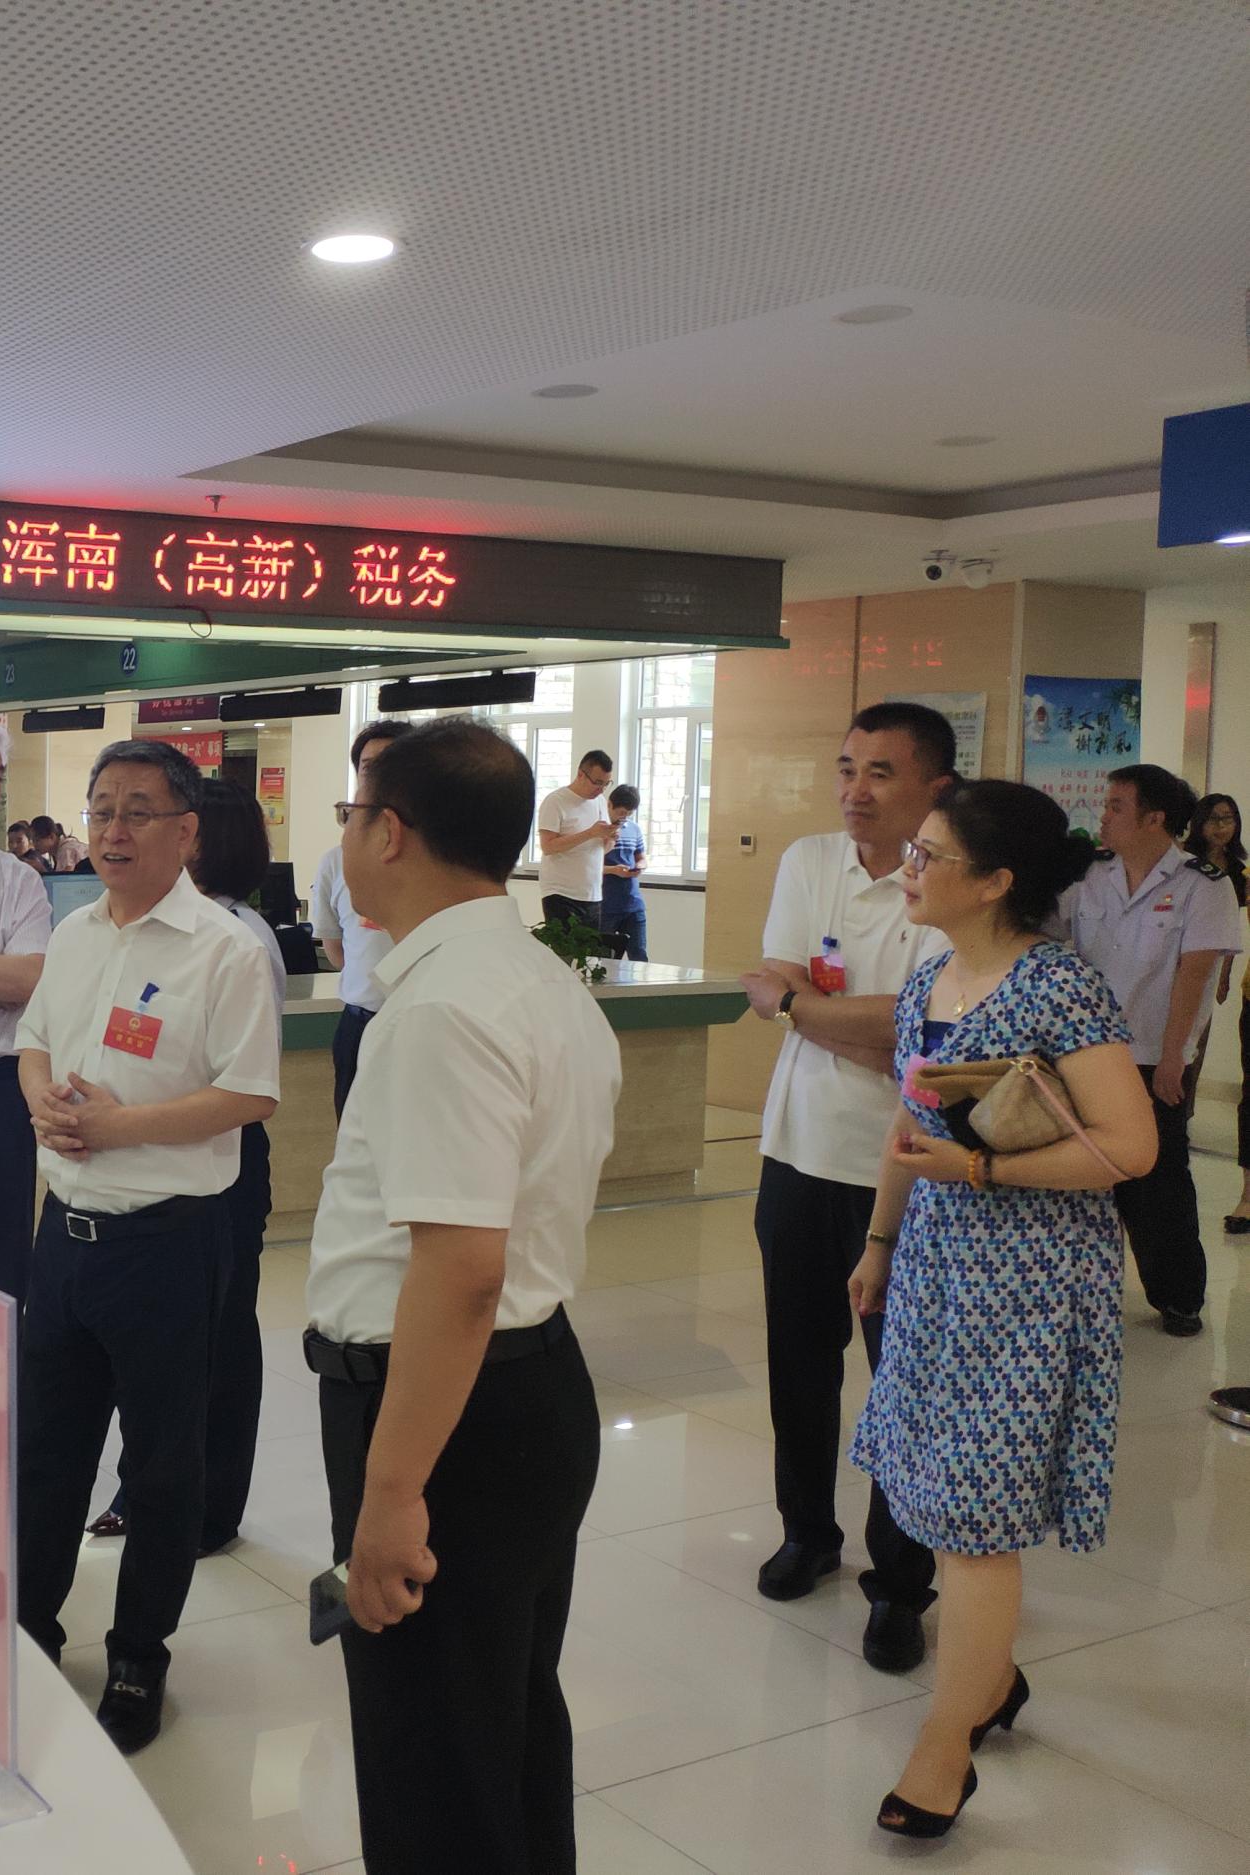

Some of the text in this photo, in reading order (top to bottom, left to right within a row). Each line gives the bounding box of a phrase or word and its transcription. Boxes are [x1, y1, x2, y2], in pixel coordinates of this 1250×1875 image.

[1, 520, 457, 609] 浑南（高新）税务
[122, 648, 136, 671] 22
[5, 664, 15, 683] 23
